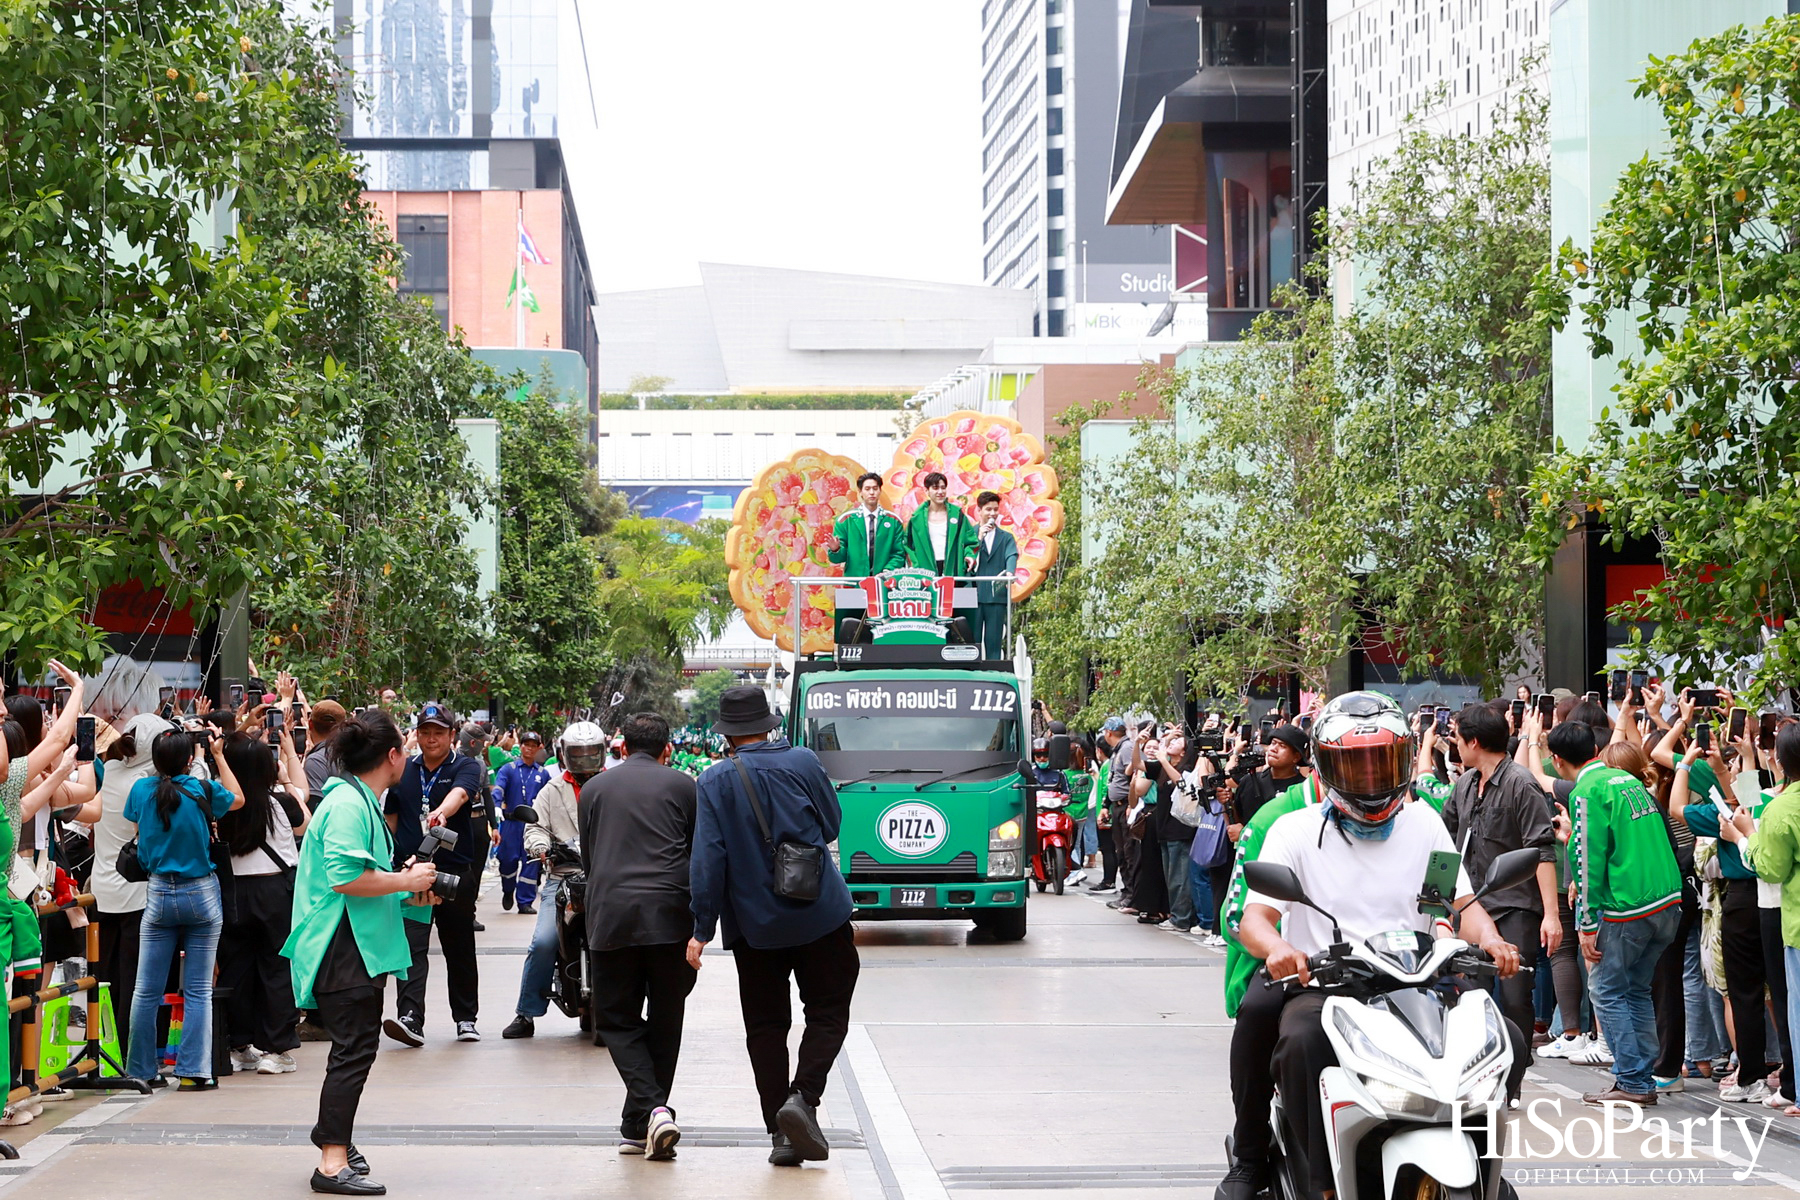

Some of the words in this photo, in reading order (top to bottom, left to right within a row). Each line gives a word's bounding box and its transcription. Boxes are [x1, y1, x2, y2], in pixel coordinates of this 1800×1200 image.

[1085, 313, 1122, 328] MBK
[888, 601, 932, 617] แถม
[841, 647, 863, 659] 1112
[807, 692, 842, 710] เดอะ
[846, 686, 892, 710] พิซซ่า
[896, 687, 957, 710] คอมปะนี
[969, 688, 1017, 713] 1112
[1620, 784, 1659, 821] 111
[889, 818, 937, 839] PIZZA
[899, 840, 926, 848] COMPANY
[900, 891, 926, 904] 1112
